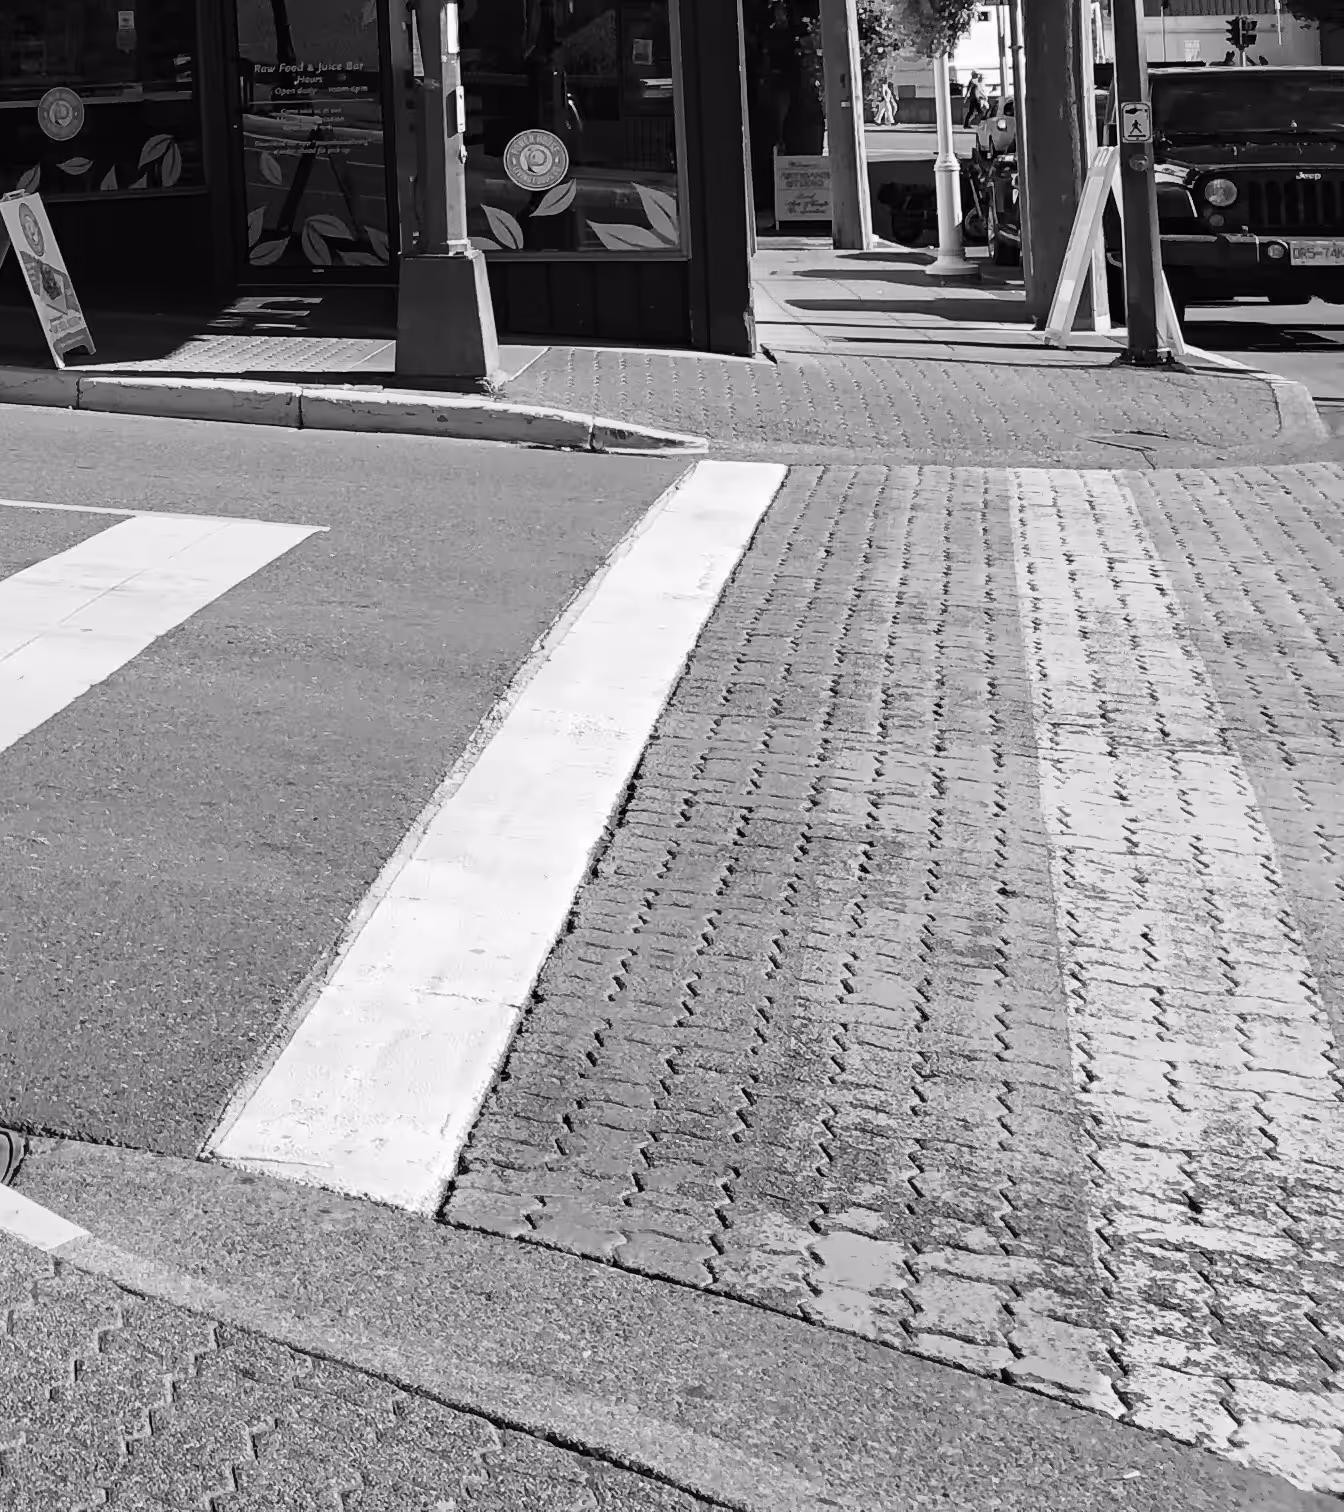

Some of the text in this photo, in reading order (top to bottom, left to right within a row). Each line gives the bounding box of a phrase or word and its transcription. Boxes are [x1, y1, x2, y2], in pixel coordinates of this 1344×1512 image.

[254, 64, 275, 73] Raw
[279, 61, 304, 73] Food
[315, 61, 343, 73] Juice
[346, 61, 364, 71] Bar
[1295, 171, 1322, 180] Jeep
